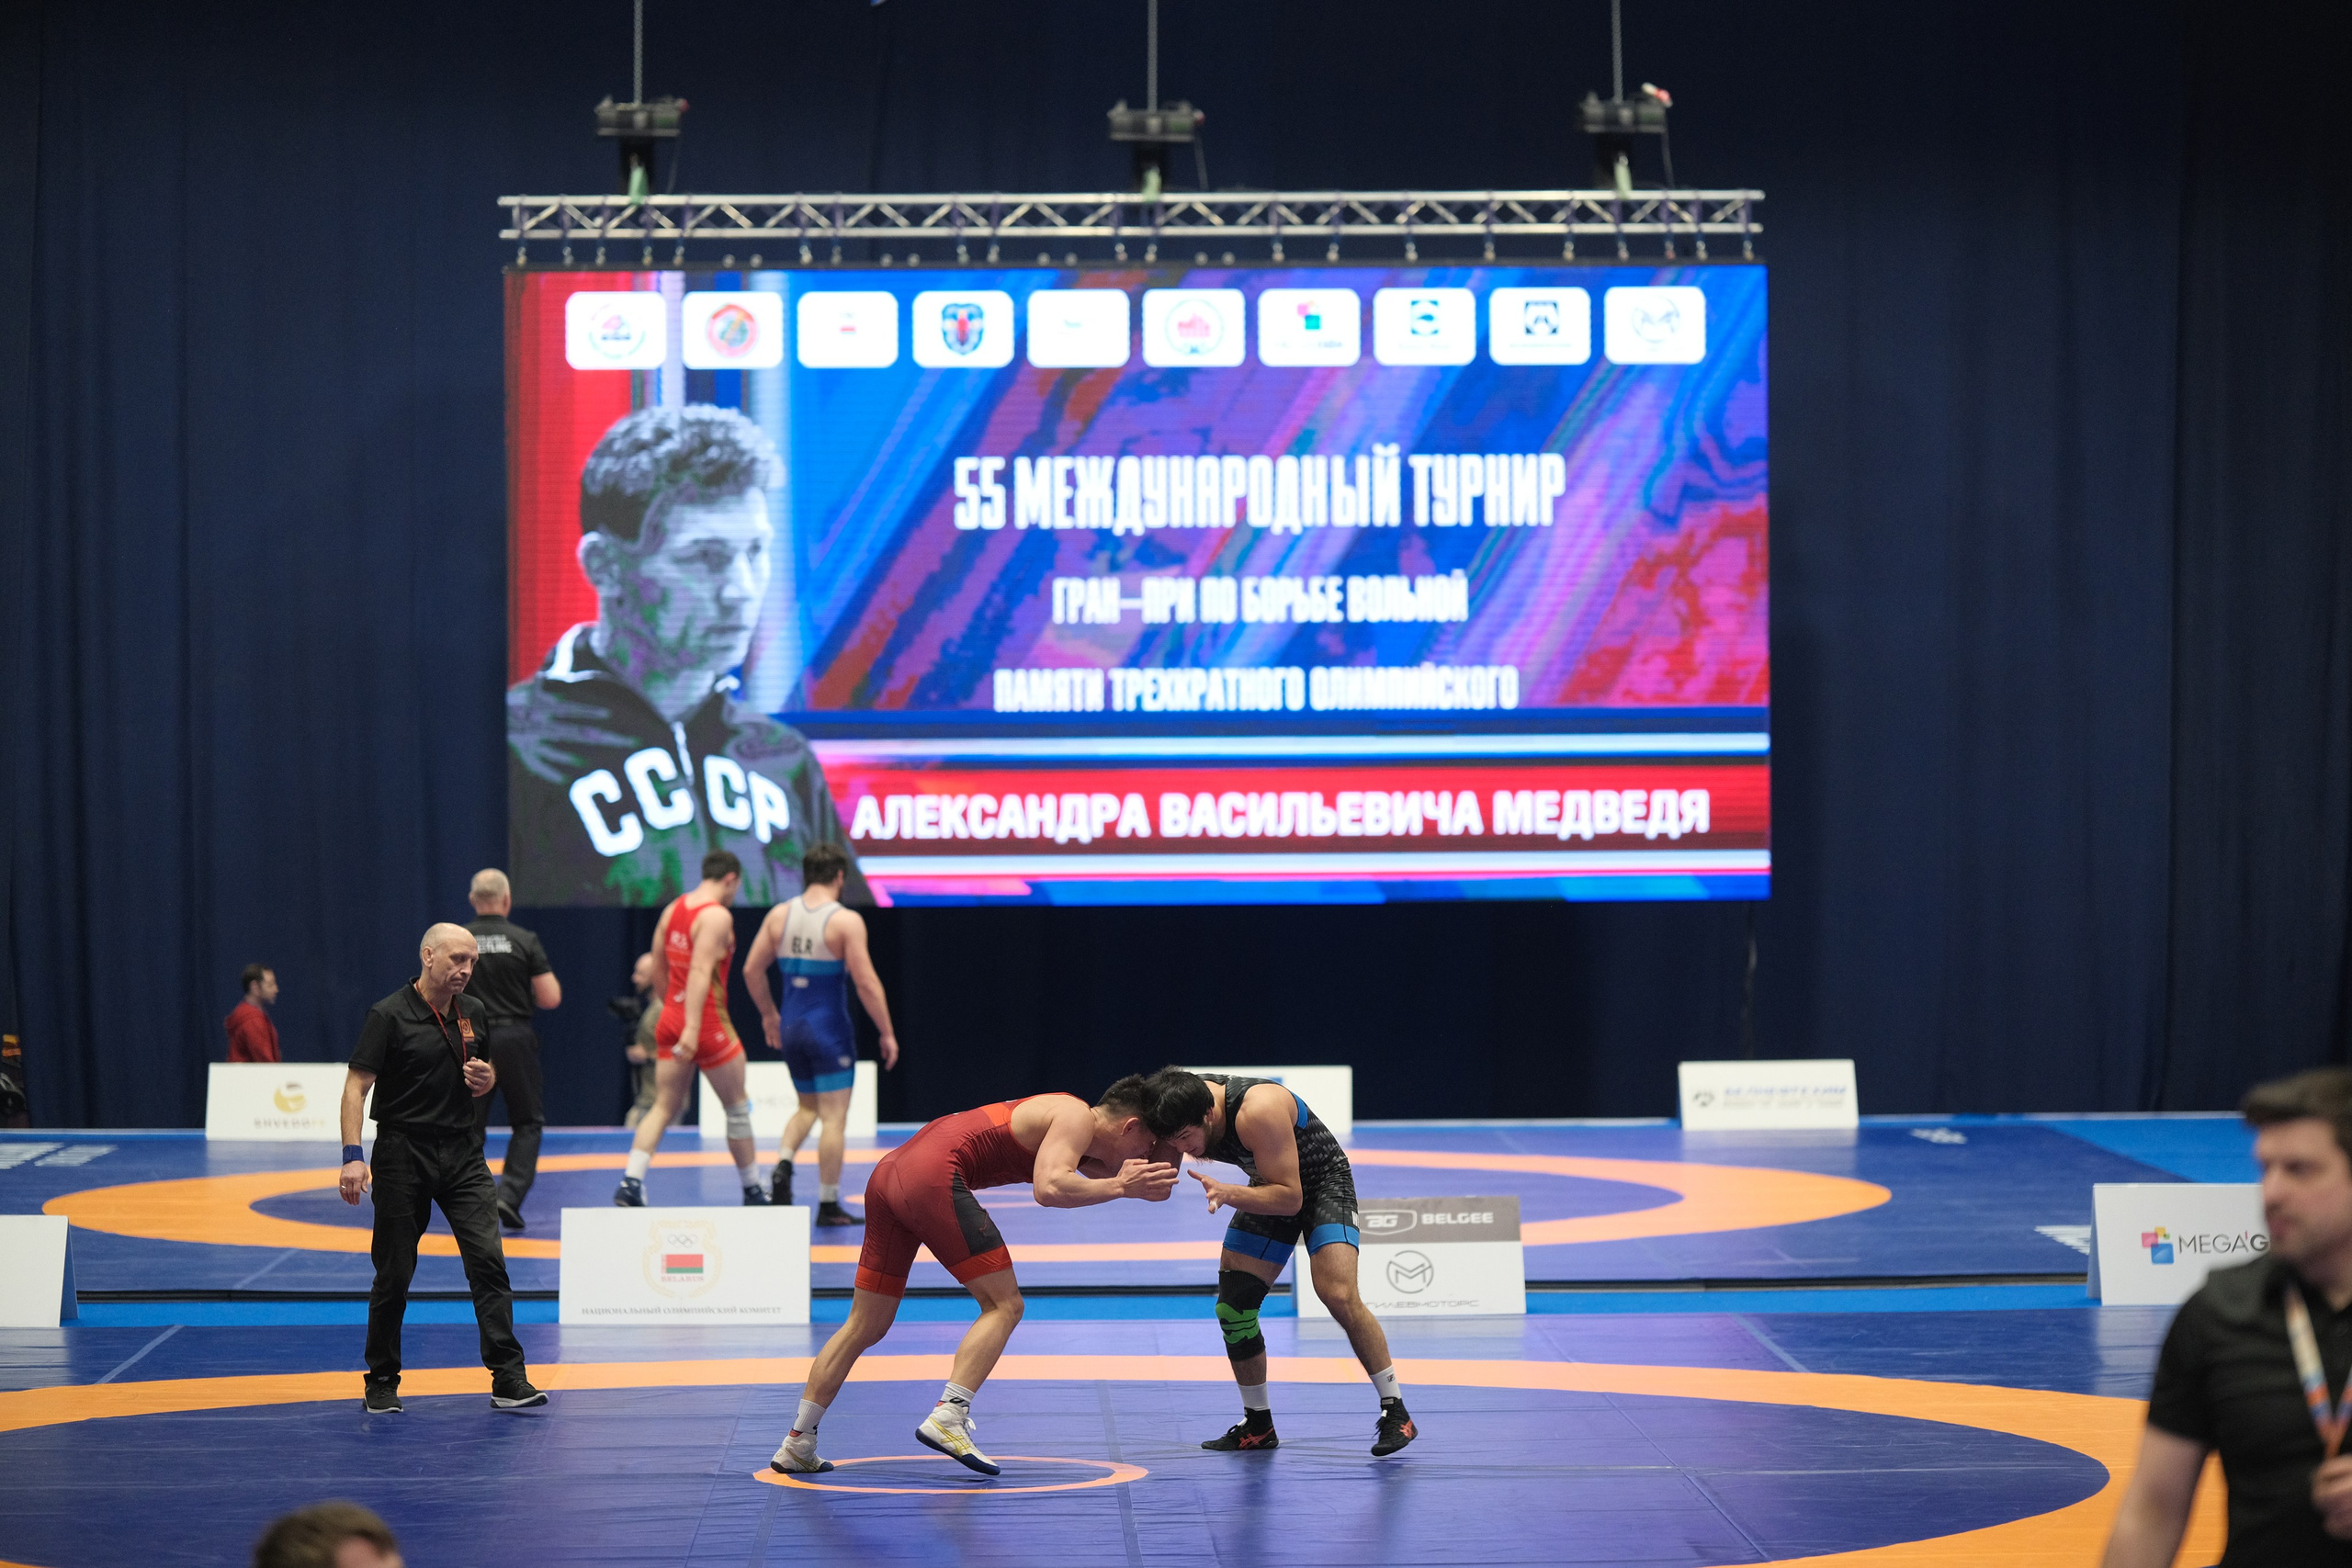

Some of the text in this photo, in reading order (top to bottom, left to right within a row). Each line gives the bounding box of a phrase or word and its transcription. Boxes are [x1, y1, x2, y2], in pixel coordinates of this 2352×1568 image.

[954, 443, 1566, 536] 55 МЕЖДУНАРОДНЫЙ ТУРНИР
[1200, 577, 1238, 624] ПО
[1241, 576, 1344, 623] БОРЬБЕ
[1347, 569, 1468, 623] ВОЛЬНОЙ
[993, 668, 1104, 712] ПАМЯТИ
[569, 747, 790, 856] СССР
[849, 788, 1710, 844] АЛЕКСАНДРА ВАСИЛЬЕВИЧА МЕДВЕДЯ
[1421, 1212, 1494, 1225] BELGEE
[2178, 1230, 2269, 1254] MEGA'G
[1365, 1299, 1480, 1309] ГИЛЕВМОТОРС
